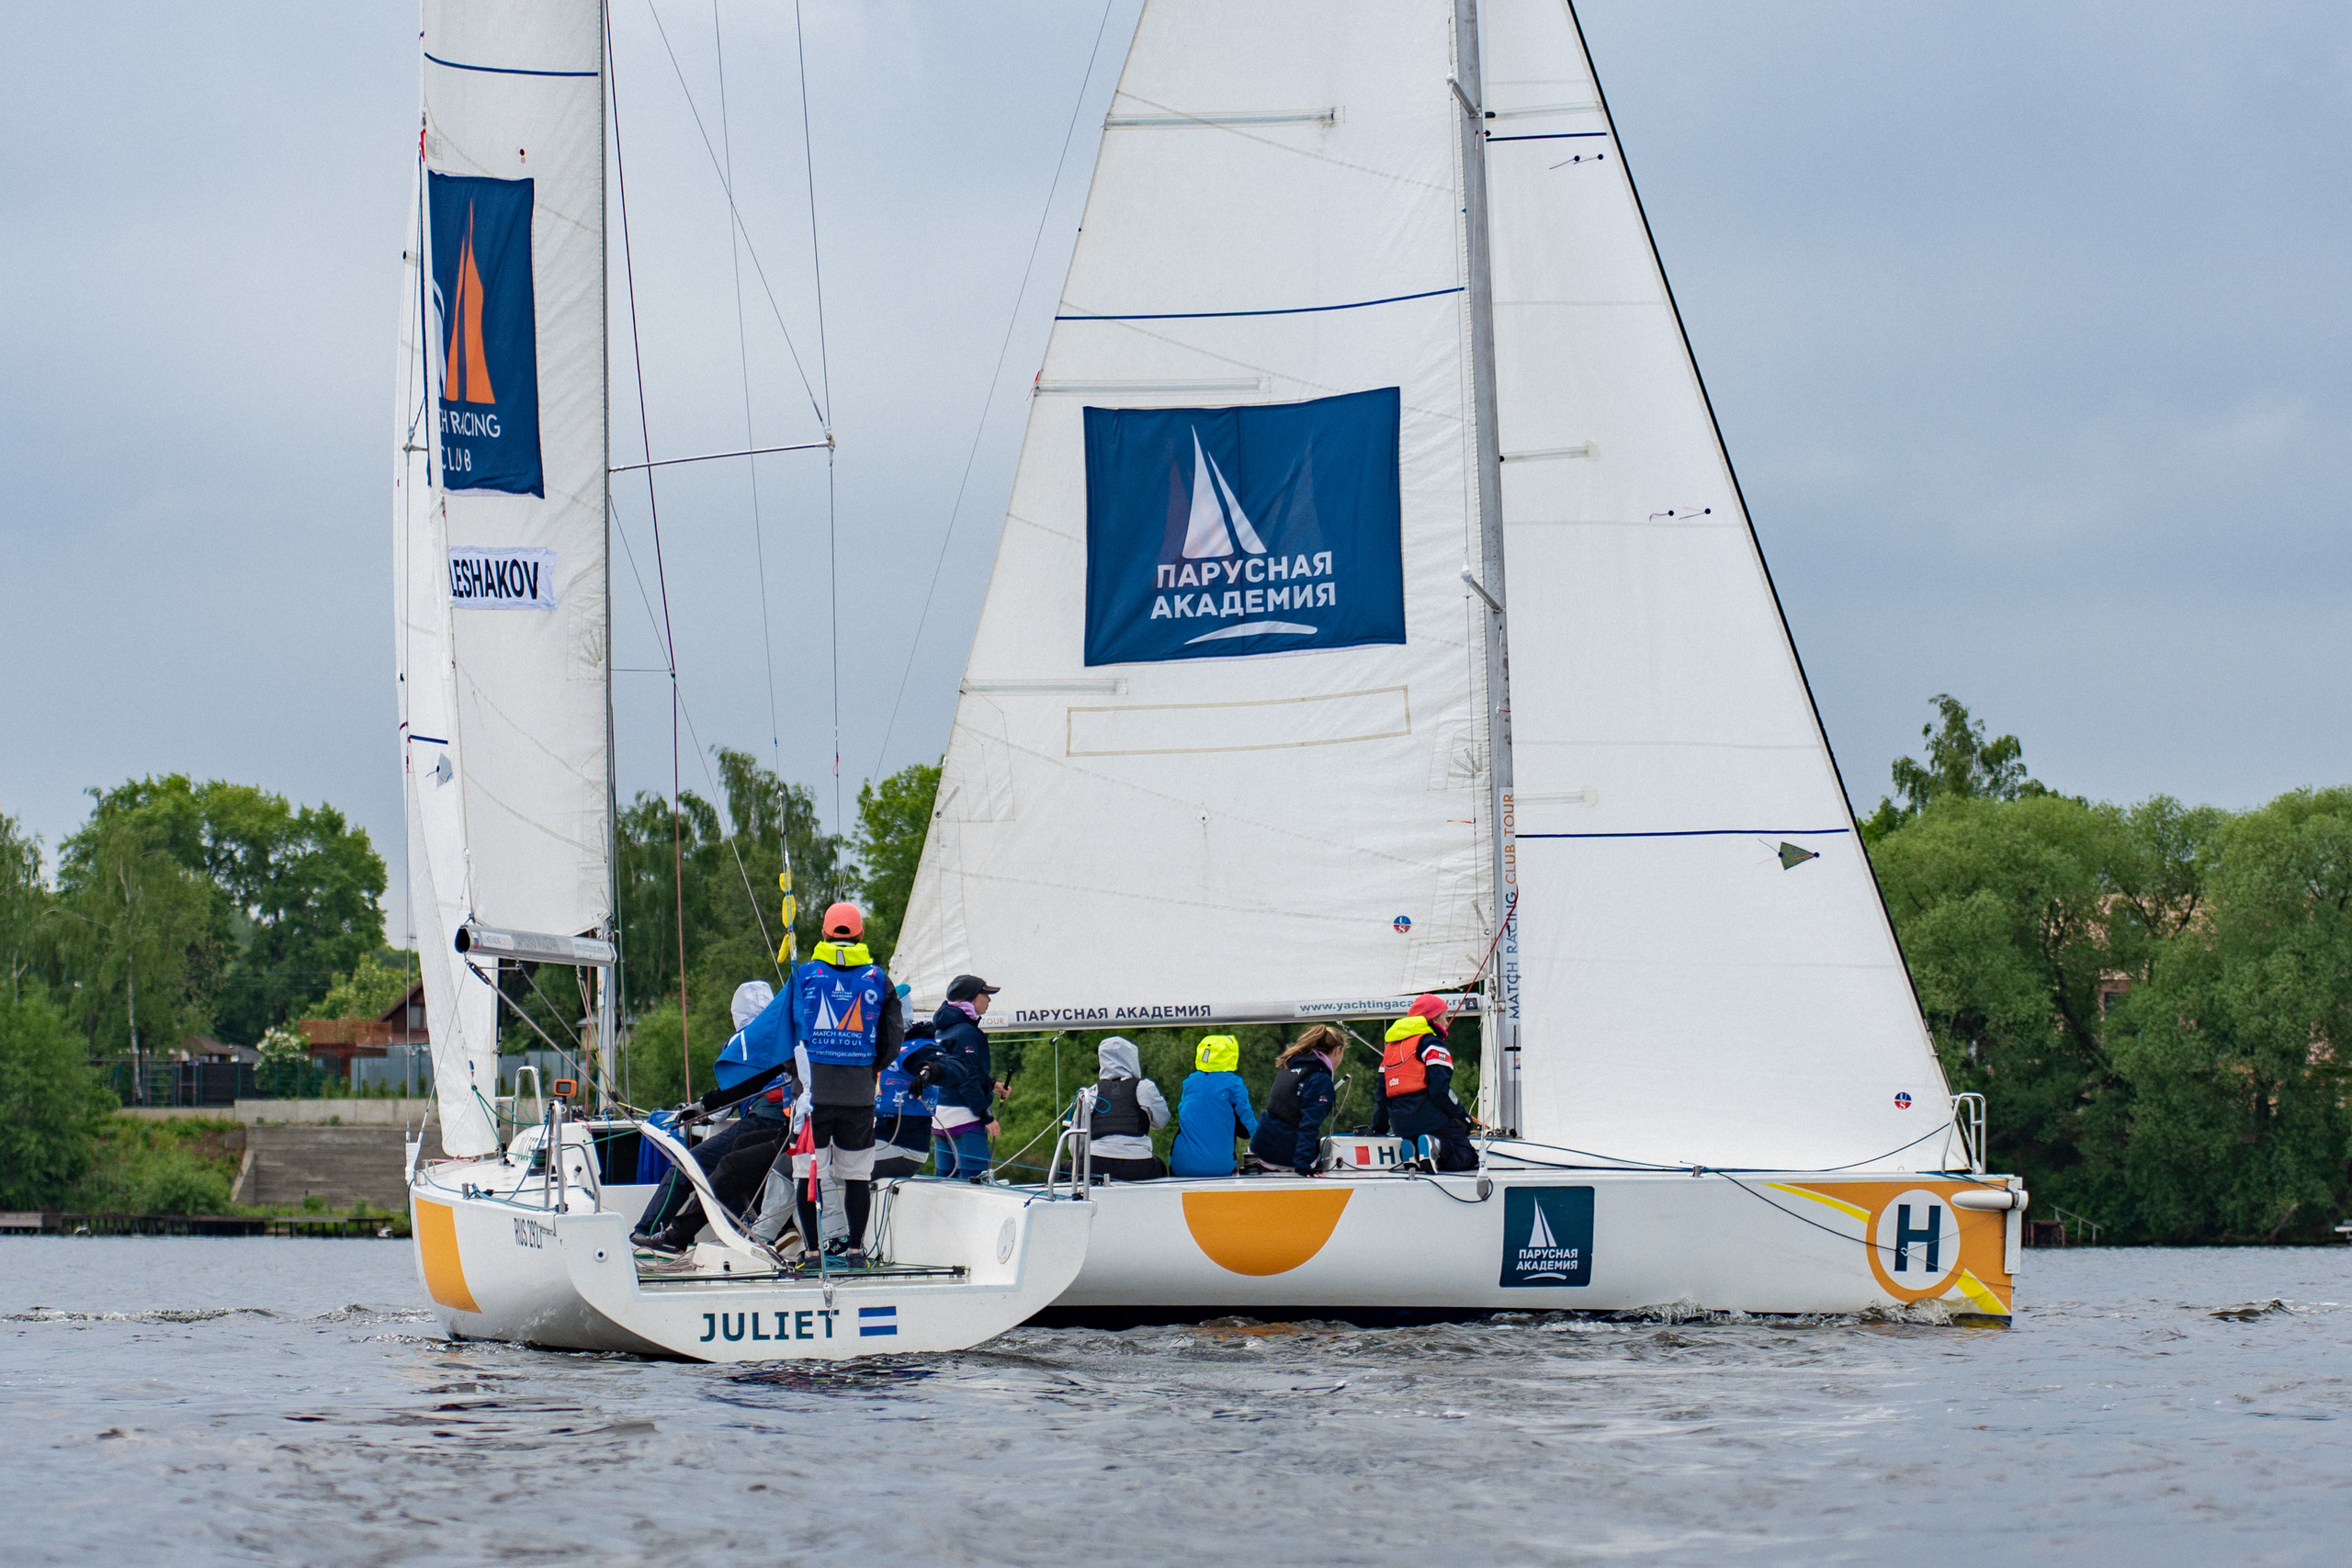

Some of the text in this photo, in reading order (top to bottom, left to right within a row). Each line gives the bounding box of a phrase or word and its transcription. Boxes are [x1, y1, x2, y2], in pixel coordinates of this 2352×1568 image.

[449, 411, 501, 438] RACING
[1156, 550, 1333, 589] ПАРУСНАЯ
[1149, 581, 1337, 620] АКАДЕМИЯ
[1502, 793, 1520, 1020] MATCH RACING CLUB TOUR
[982, 1017, 1004, 1025] TOUR
[1015, 1005, 1212, 1022] ПАРУСНАЯ АКАДЕМИЯ
[811, 1037, 835, 1045] CLUB
[838, 1031, 863, 1039] RACING
[514, 1217, 527, 1247] RUS
[1894, 1203, 1941, 1273] H
[1515, 1259, 1578, 1271] АКАДЕМИЯ
[1518, 1248, 1578, 1259] ПАРУСНАЯ
[699, 1309, 840, 1343] JULIET
